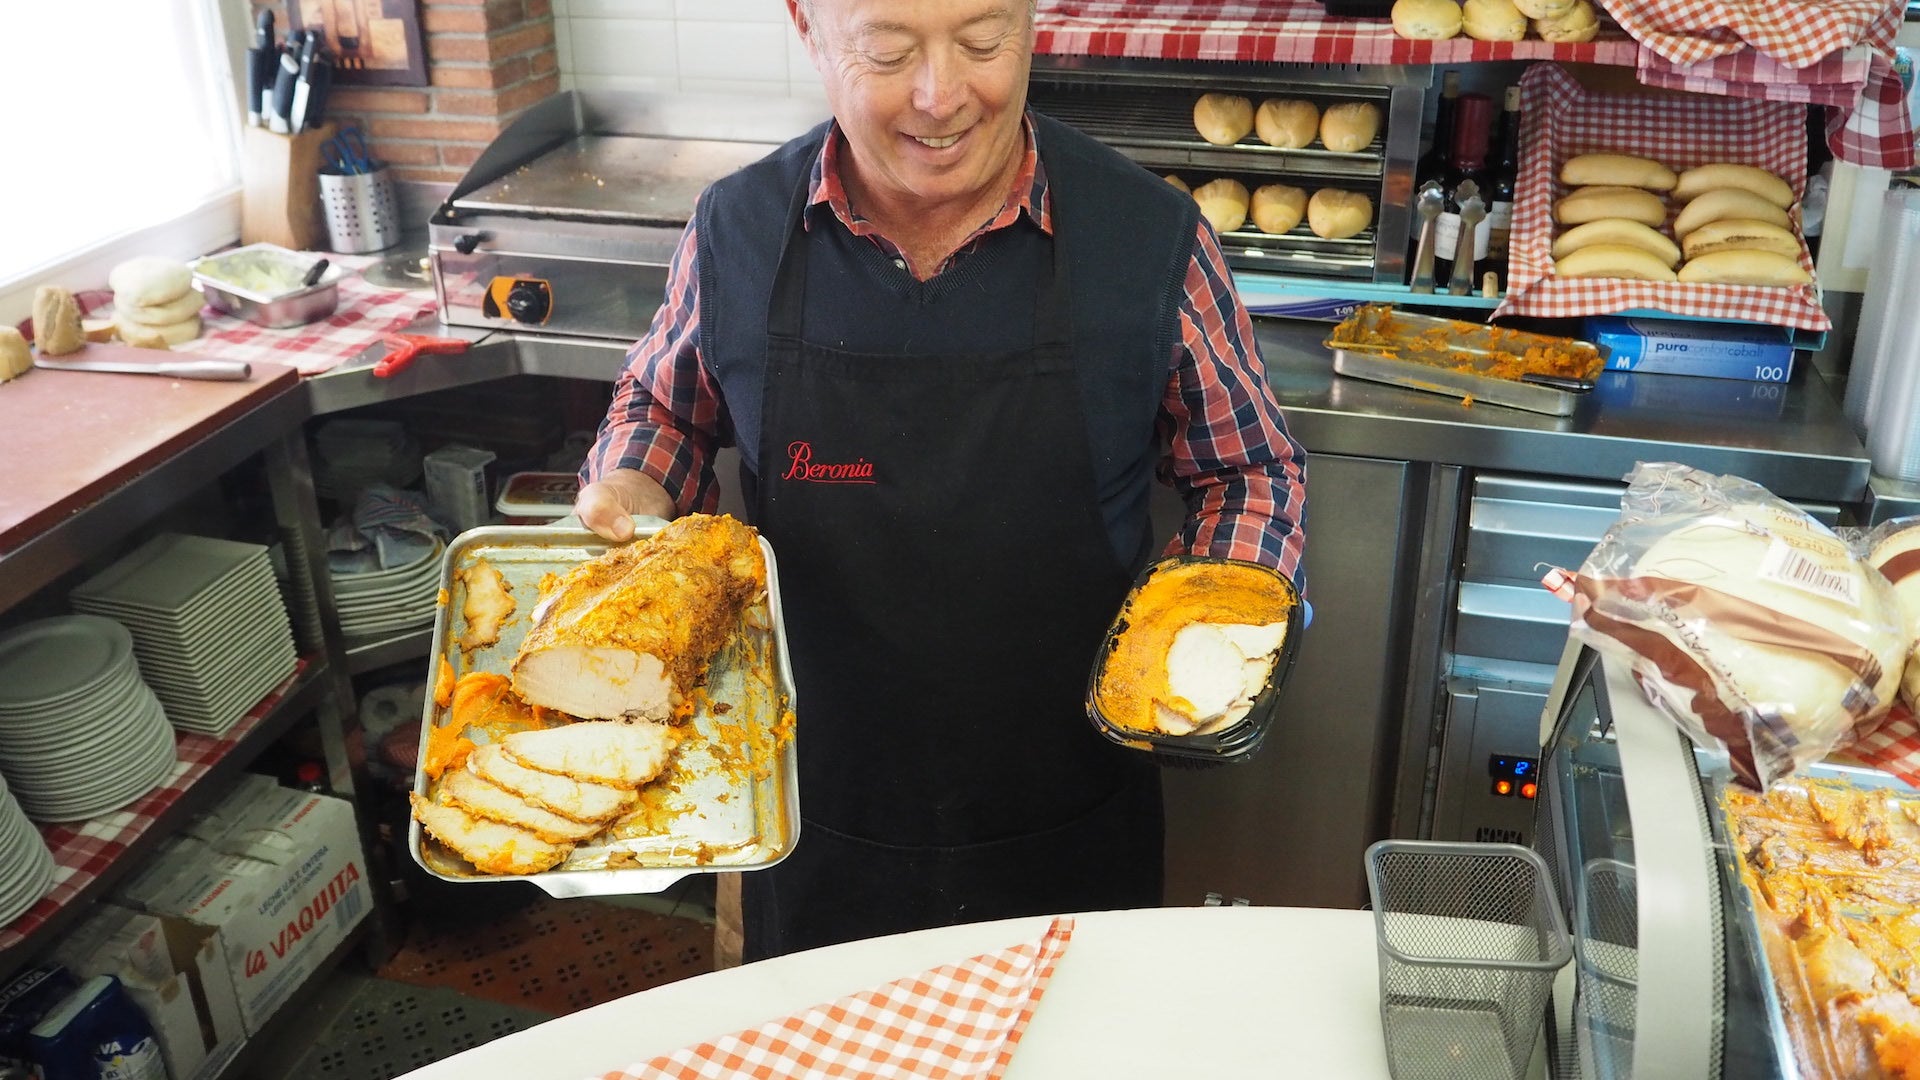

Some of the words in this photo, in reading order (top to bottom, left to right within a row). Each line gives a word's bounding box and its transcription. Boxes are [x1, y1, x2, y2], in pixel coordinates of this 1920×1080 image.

[1616, 356, 1630, 369] M
[1755, 365, 1783, 381] 100
[781, 441, 874, 481] Beronia
[269, 861, 361, 960] VAQUITA
